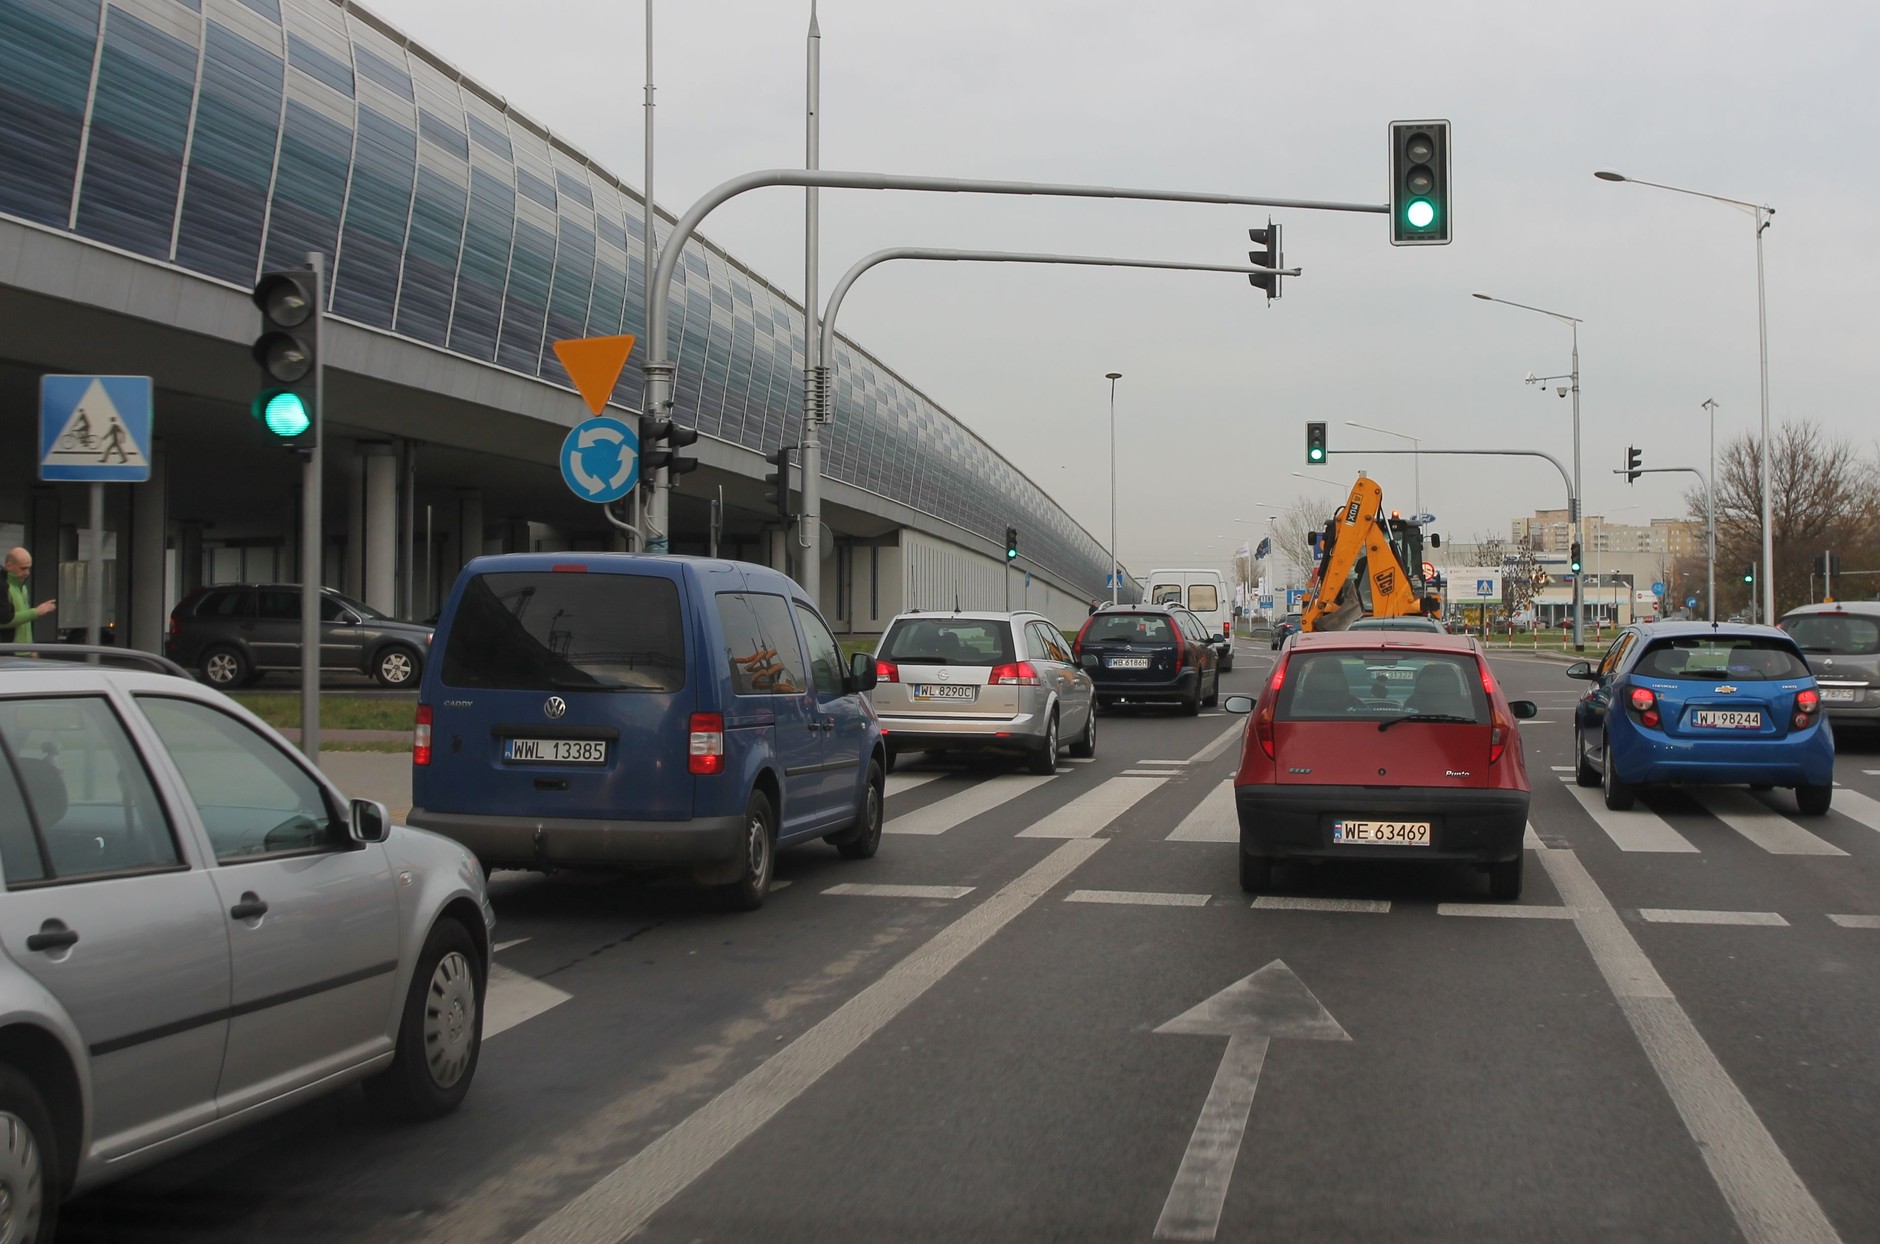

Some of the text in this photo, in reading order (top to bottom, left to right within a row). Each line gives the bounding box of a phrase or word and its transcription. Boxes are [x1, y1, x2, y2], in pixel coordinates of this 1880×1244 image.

[1375, 572, 1393, 595] JCB
[1112, 658, 1123, 668] WB
[921, 685, 971, 698] WL 8290C
[1699, 712, 1760, 725] WJ 98244
[514, 741, 604, 760] WWL 13385
[1345, 823, 1427, 841] WE 63469
